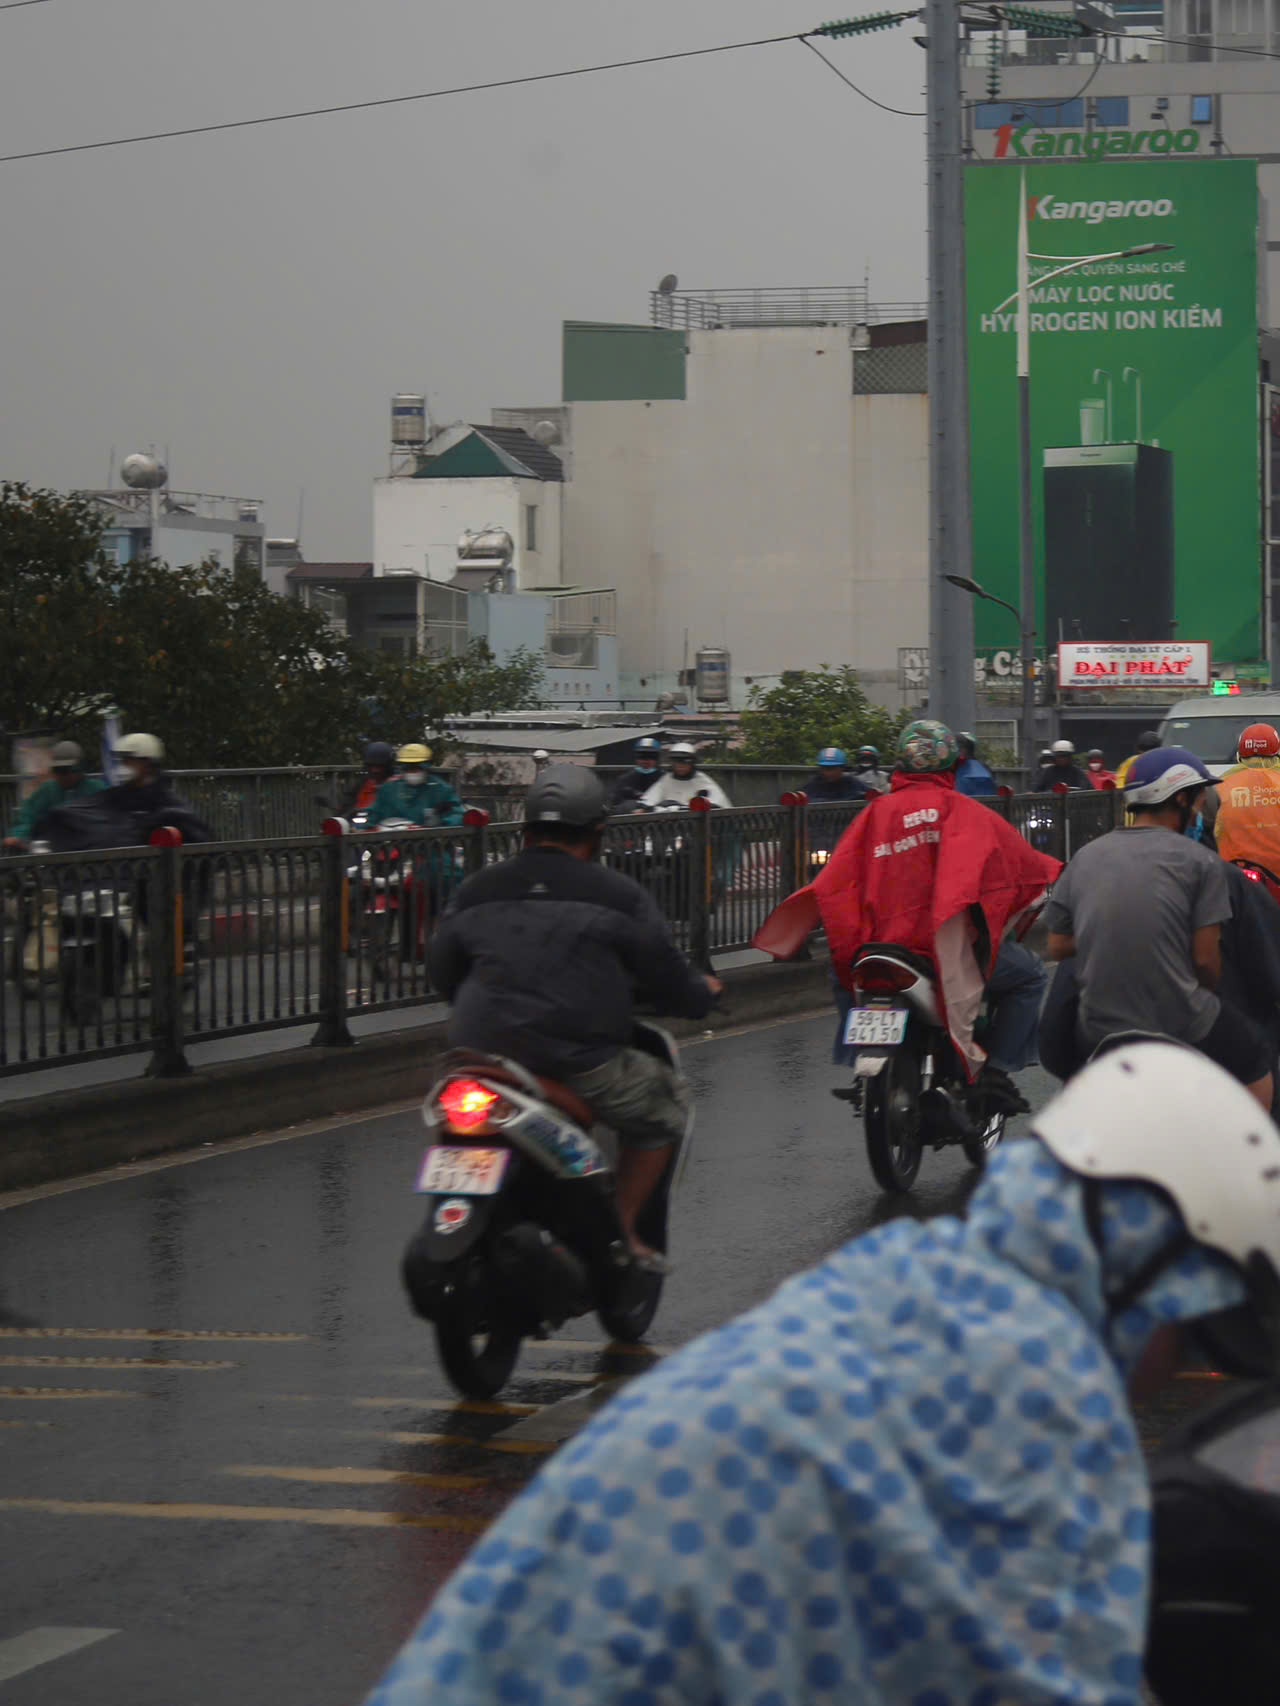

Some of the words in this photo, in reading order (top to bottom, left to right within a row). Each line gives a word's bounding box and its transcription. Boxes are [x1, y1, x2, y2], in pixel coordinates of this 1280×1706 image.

[1077, 285, 1115, 306] LỌC
[1119, 281, 1175, 302] NƯỚC
[980, 310, 1109, 333] HYROGEN
[1115, 309, 1156, 330] ION
[1074, 660, 1119, 679] ĐẠI
[902, 808, 939, 829] HEAD
